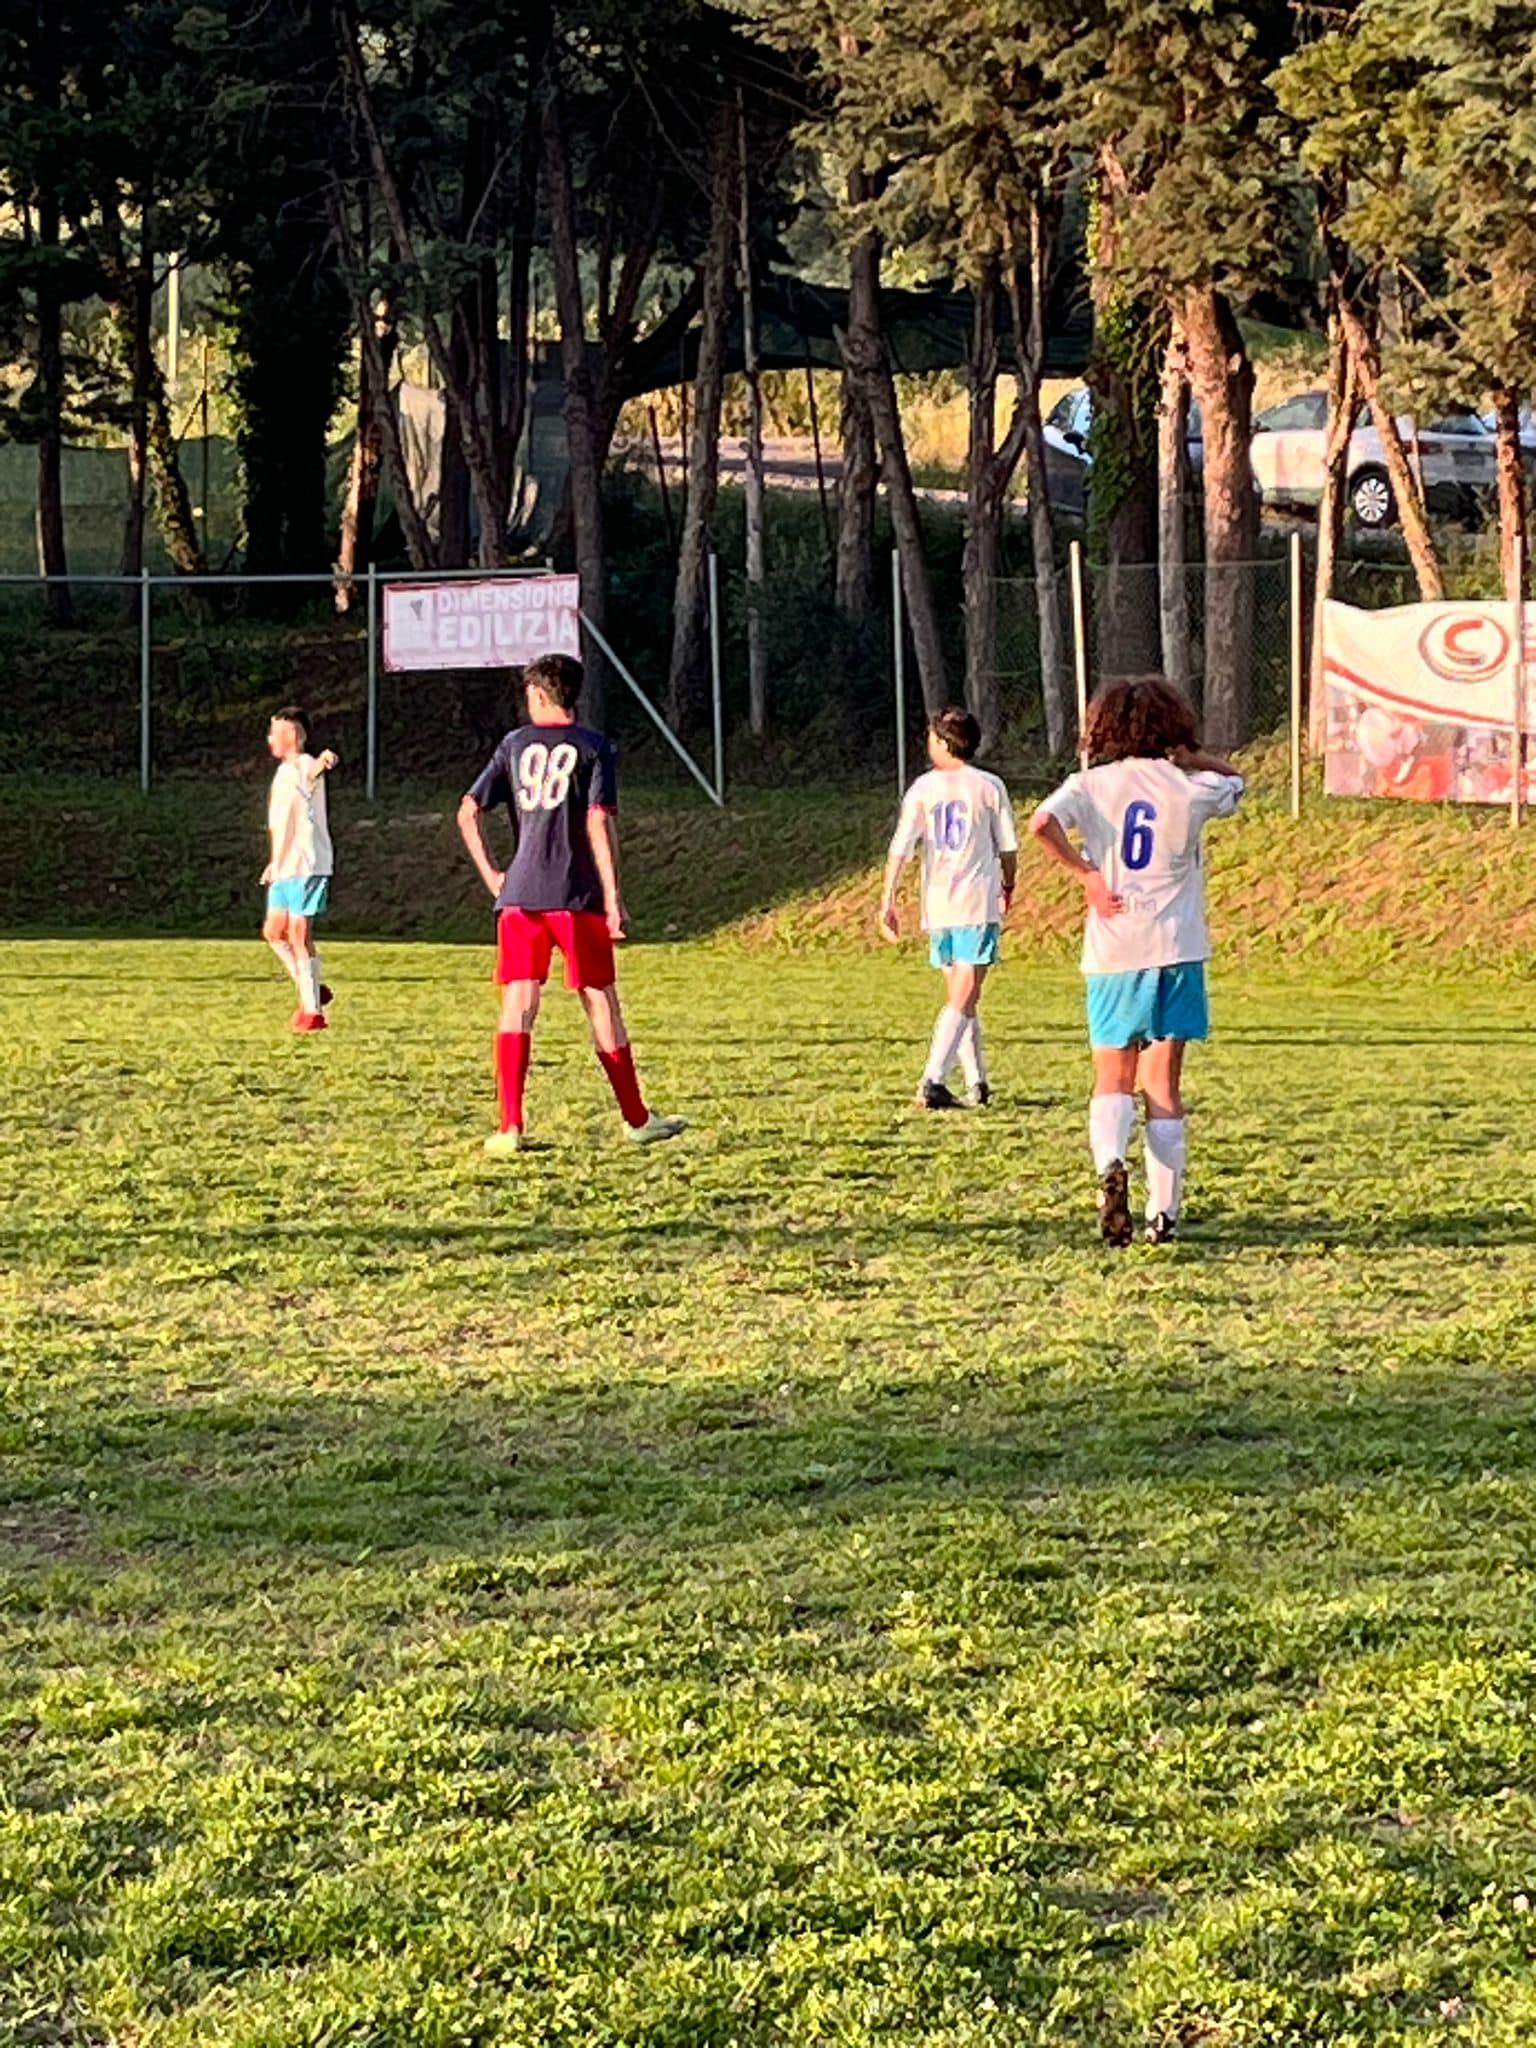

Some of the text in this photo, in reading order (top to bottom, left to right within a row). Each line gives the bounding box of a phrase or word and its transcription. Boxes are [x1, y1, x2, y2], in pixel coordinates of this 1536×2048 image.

[437, 584, 575, 614] DIMENSIONE
[437, 608, 575, 648] EDILIZIA
[517, 742, 578, 811] 98
[930, 799, 968, 850] 16
[1120, 800, 1157, 870] 6
